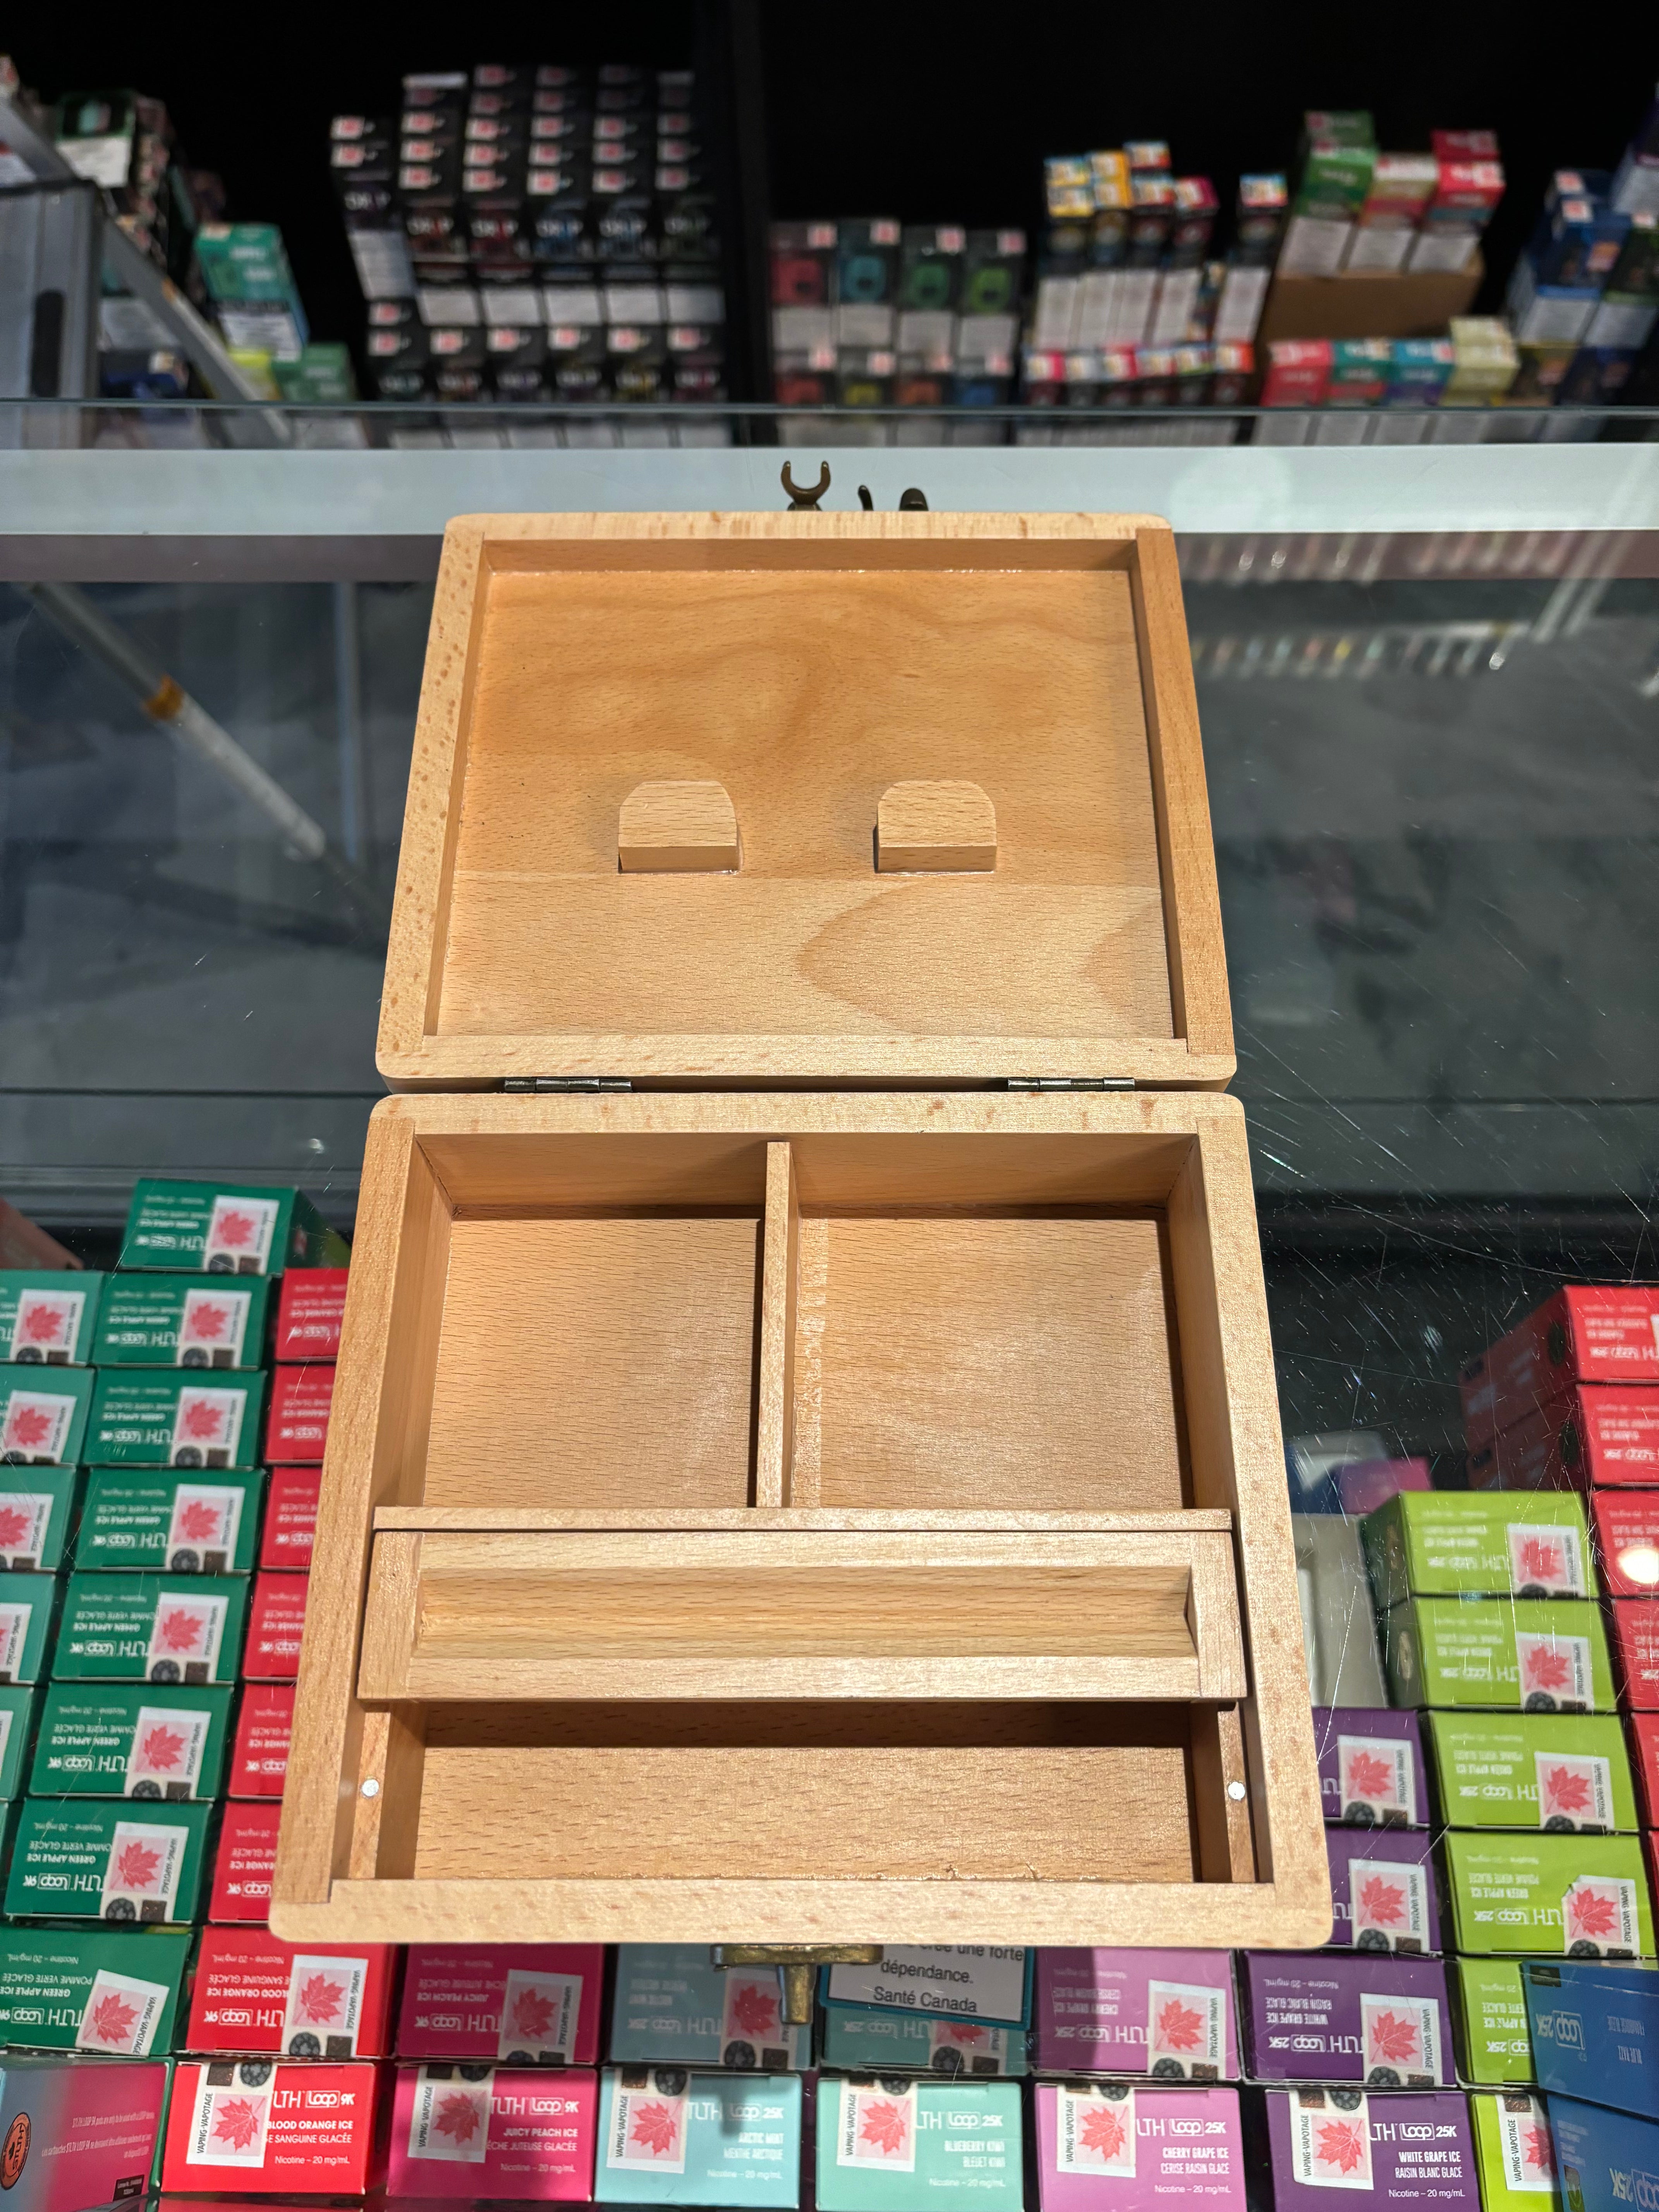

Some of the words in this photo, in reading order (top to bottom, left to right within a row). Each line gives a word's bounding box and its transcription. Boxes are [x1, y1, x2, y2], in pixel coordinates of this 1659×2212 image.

[27, 1853, 41, 1862] ICE
[42, 1854, 67, 1863] APPLE
[69, 1855, 96, 1864] GREEN
[881, 1960, 974, 1984] dépendance.
[3, 1973, 34, 1984] GLACÉE
[36, 1975, 58, 1983] VERTE
[0, 1987, 14, 1995] ICE
[15, 1987, 41, 1996] APPLE
[43, 1988, 71, 1997] GREEN
[207, 1987, 221, 1996] ICE
[223, 1988, 259, 1997] ORANGE
[874, 1986, 916, 2004] Santé
[920, 1992, 977, 2013] Canada
[49, 2009, 82, 2027] TLTH
[1266, 2013, 1277, 2023] ICE
[1280, 2013, 1302, 2023] GRAPE
[1305, 2014, 1328, 2024] WHITE
[1483, 2017, 1495, 2028] ICE
[1497, 2018, 1518, 2028] APPLE
[1269, 2037, 1290, 2047] 25K
[1329, 2036, 1363, 2053] TLTH
[1486, 2041, 1506, 2052] 25K
[340, 2093, 355, 2106] 9K
[299, 2121, 337, 2130] ORANGE
[982, 2115, 1003, 2126] 25K
[503, 2128, 530, 2136] JUICY
[532, 2128, 561, 2137] PEACH
[563, 2129, 578, 2137] ICE
[1205, 2122, 1226, 2133] 25K
[1436, 2126, 1457, 2137] 25K
[275, 2135, 317, 2143] SANGUINE
[319, 2133, 352, 2143] GLACÉE
[487, 2141, 508, 2150] ÊCHE
[544, 2141, 577, 2151] GLACÉE
[1162, 2148, 1190, 2158] CHERRY
[1192, 2148, 1215, 2158] GRAPE
[1217, 2148, 1229, 2158] ICE
[1399, 2152, 1423, 2162] WHITE
[1425, 2152, 1447, 2162] GRAPE
[1449, 2152, 1461, 2162] ICE
[275, 2156, 305, 2164] Nicotine
[313, 2156, 321, 2164] 20
[1161, 2163, 1184, 2173] CERISE
[1185, 2163, 1207, 2173] RAISIN
[1395, 2168, 1417, 2178] RAISIN
[1419, 2168, 1440, 2178] BLANC
[1441, 2166, 1462, 2178] GLACÉ
[1389, 2189, 1419, 2197] Nicotine
[1439, 2190, 1465, 2199] mg/mL
